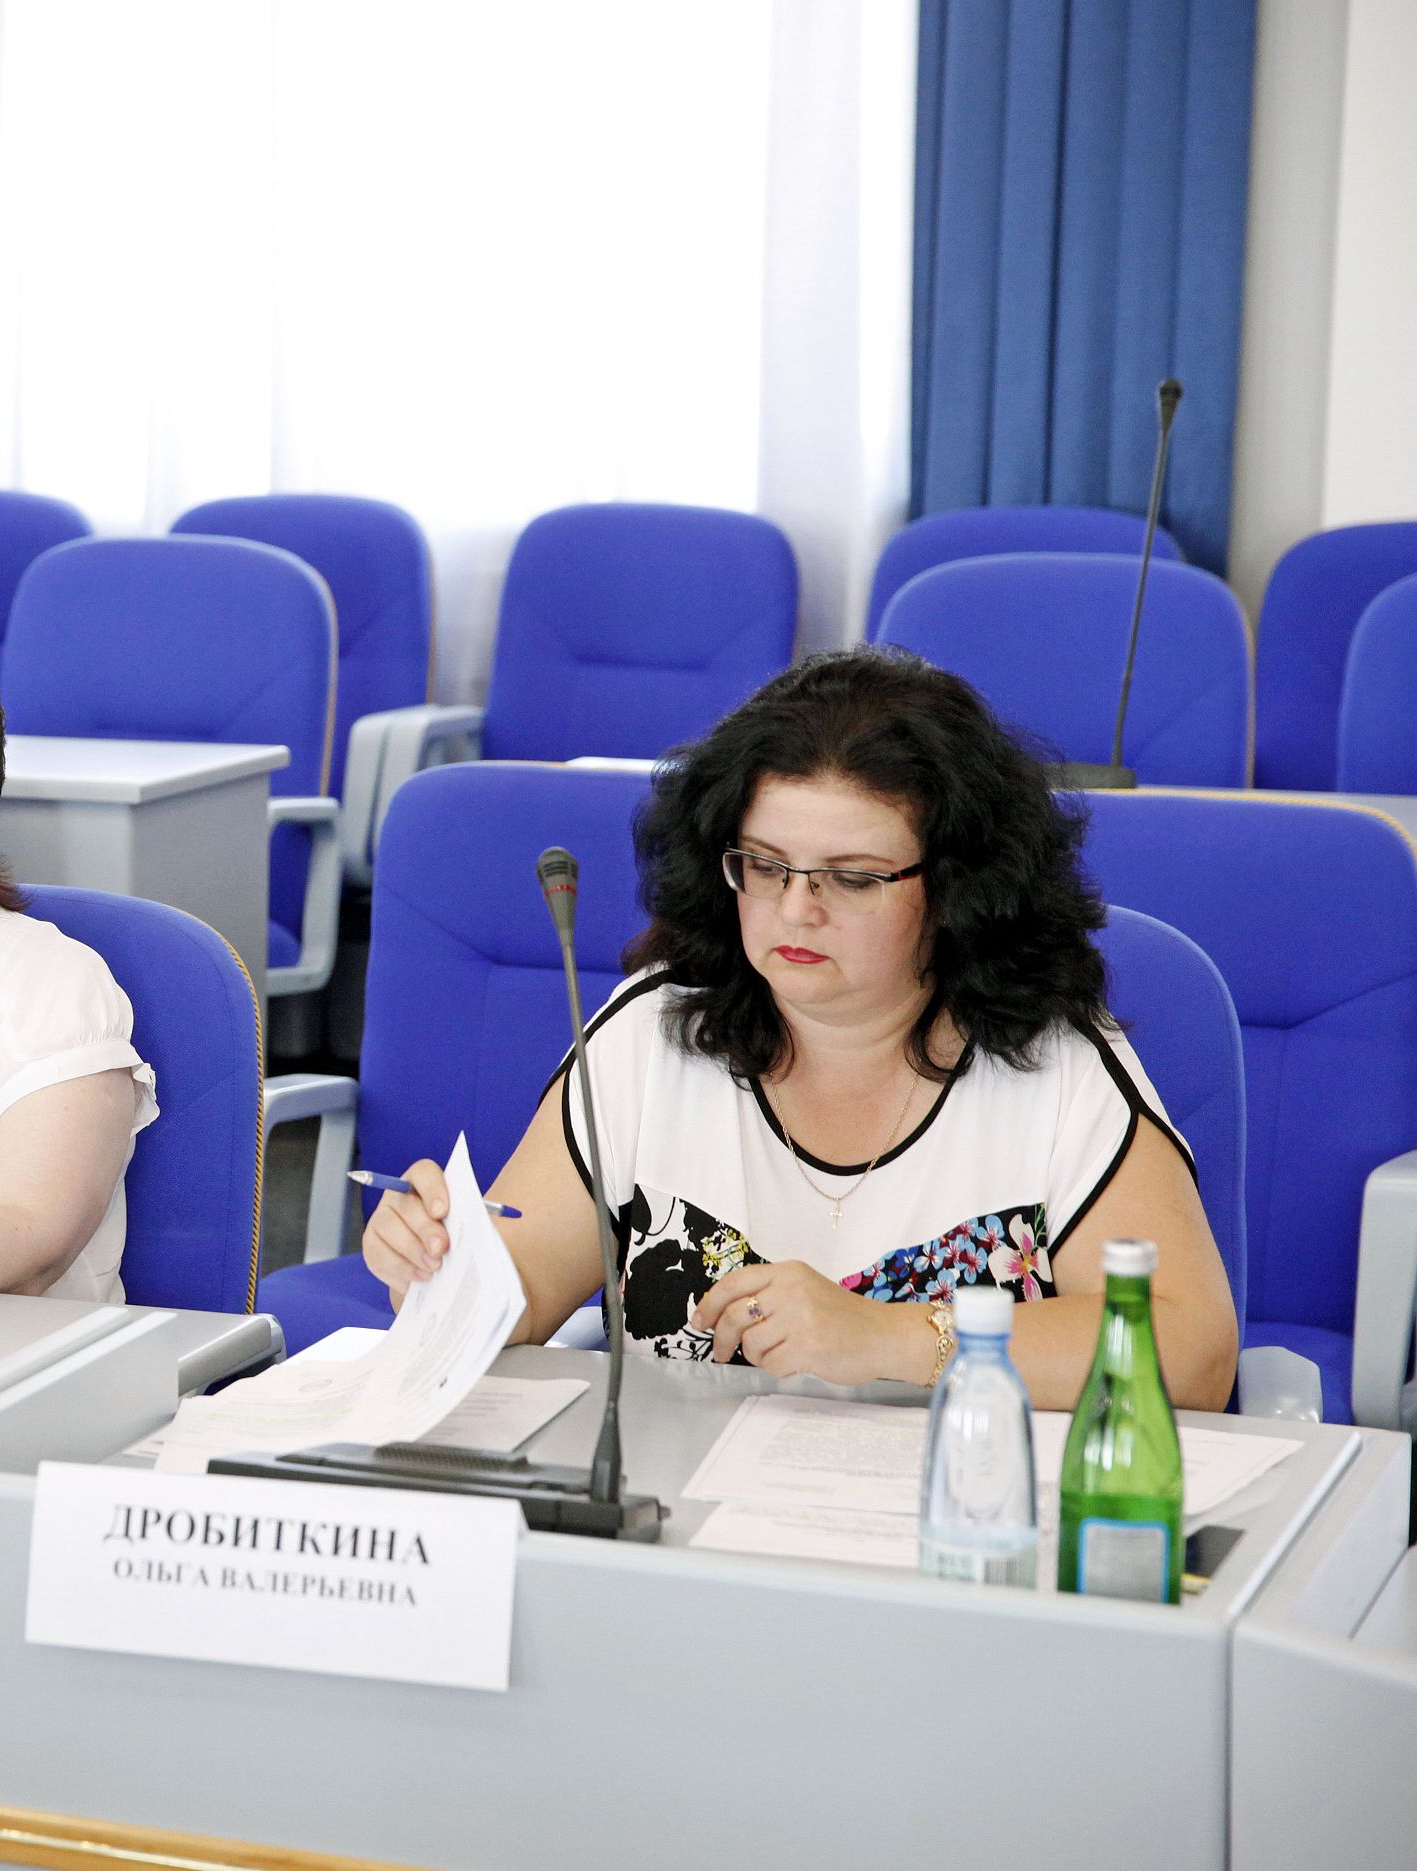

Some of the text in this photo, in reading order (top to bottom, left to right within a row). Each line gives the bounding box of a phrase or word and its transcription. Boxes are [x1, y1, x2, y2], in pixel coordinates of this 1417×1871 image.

[103, 1504, 430, 1565] ДРОБИТКИНА
[114, 1557, 418, 1607] ОЛЬГА ВАЛЕРЬЕВНА
